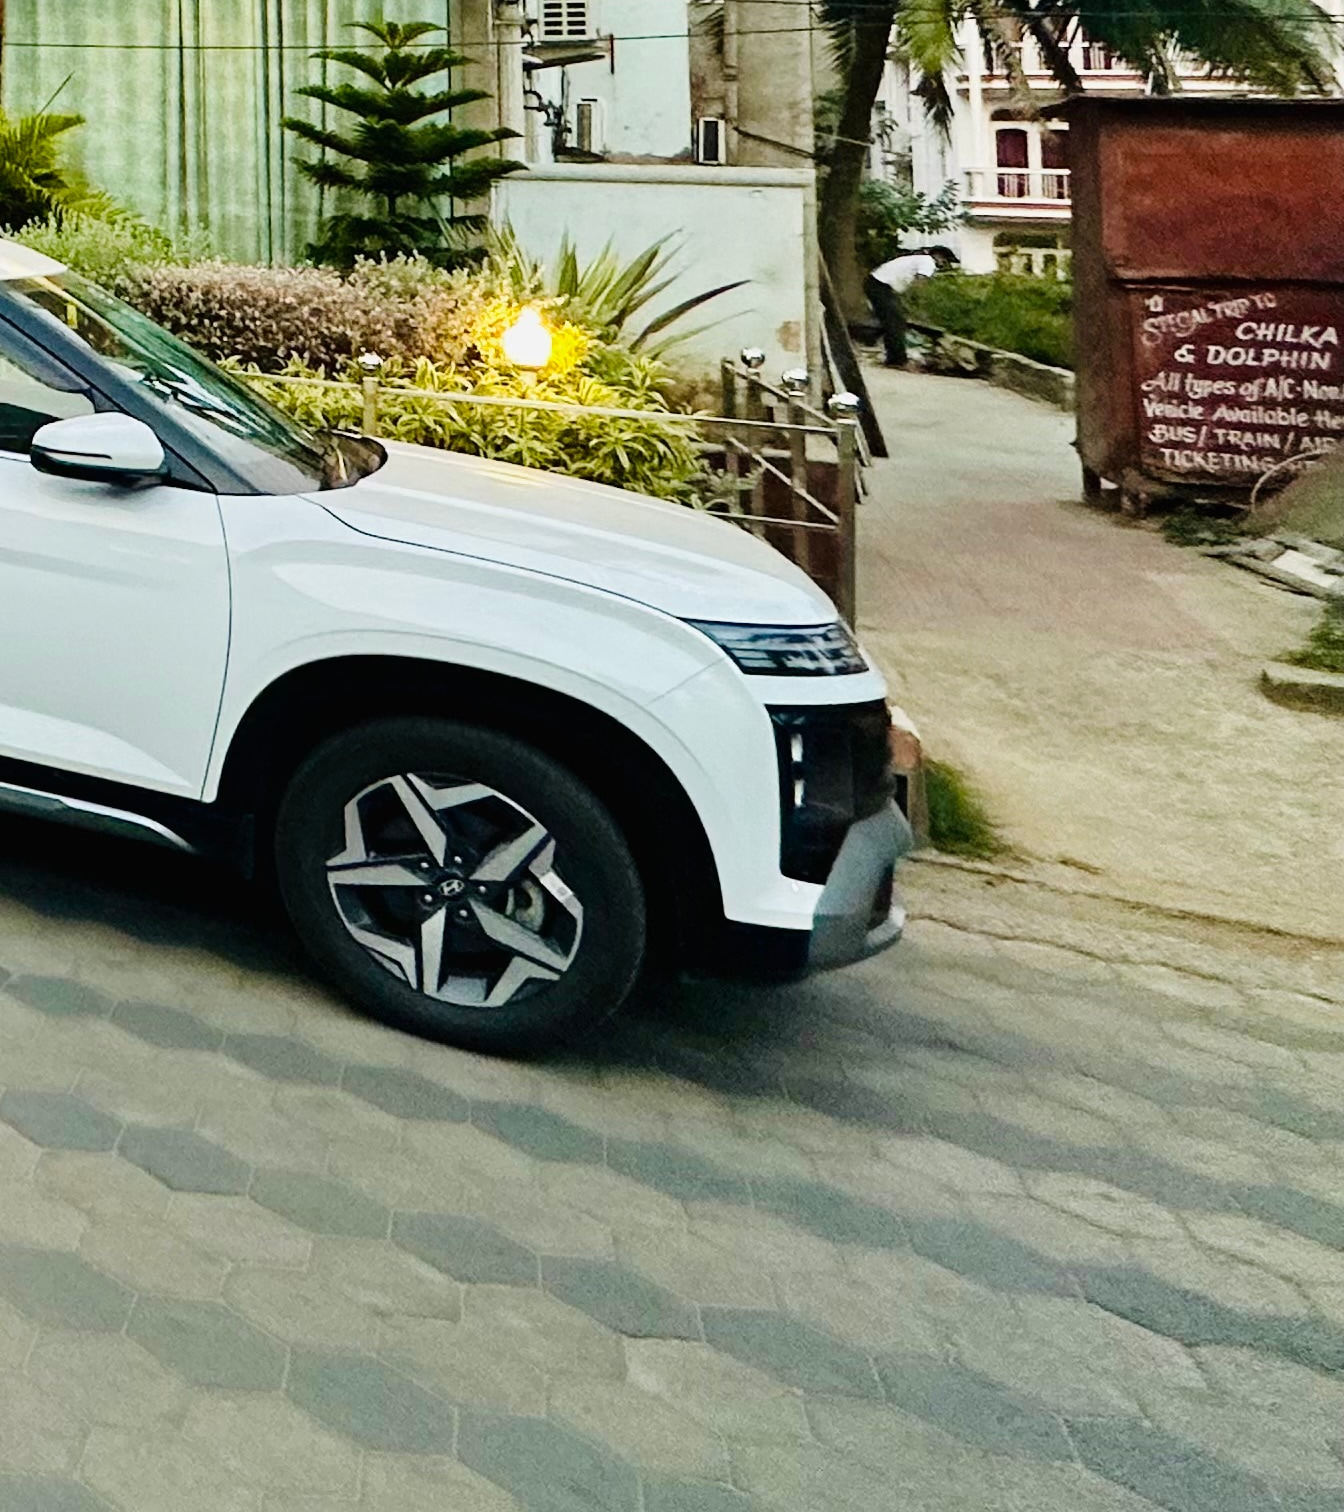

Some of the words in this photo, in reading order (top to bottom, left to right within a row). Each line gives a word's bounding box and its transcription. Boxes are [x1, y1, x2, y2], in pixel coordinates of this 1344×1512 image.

[1235, 321, 1339, 349] CHILKA
[1174, 344, 1195, 364] &
[1206, 345, 1332, 371] DOLPHIN
[1140, 371, 1181, 392] All
[1184, 372, 1236, 400] types
[1239, 377, 1264, 402] of
[1212, 403, 1309, 427] Available
[1212, 428, 1280, 451] TRAIN
